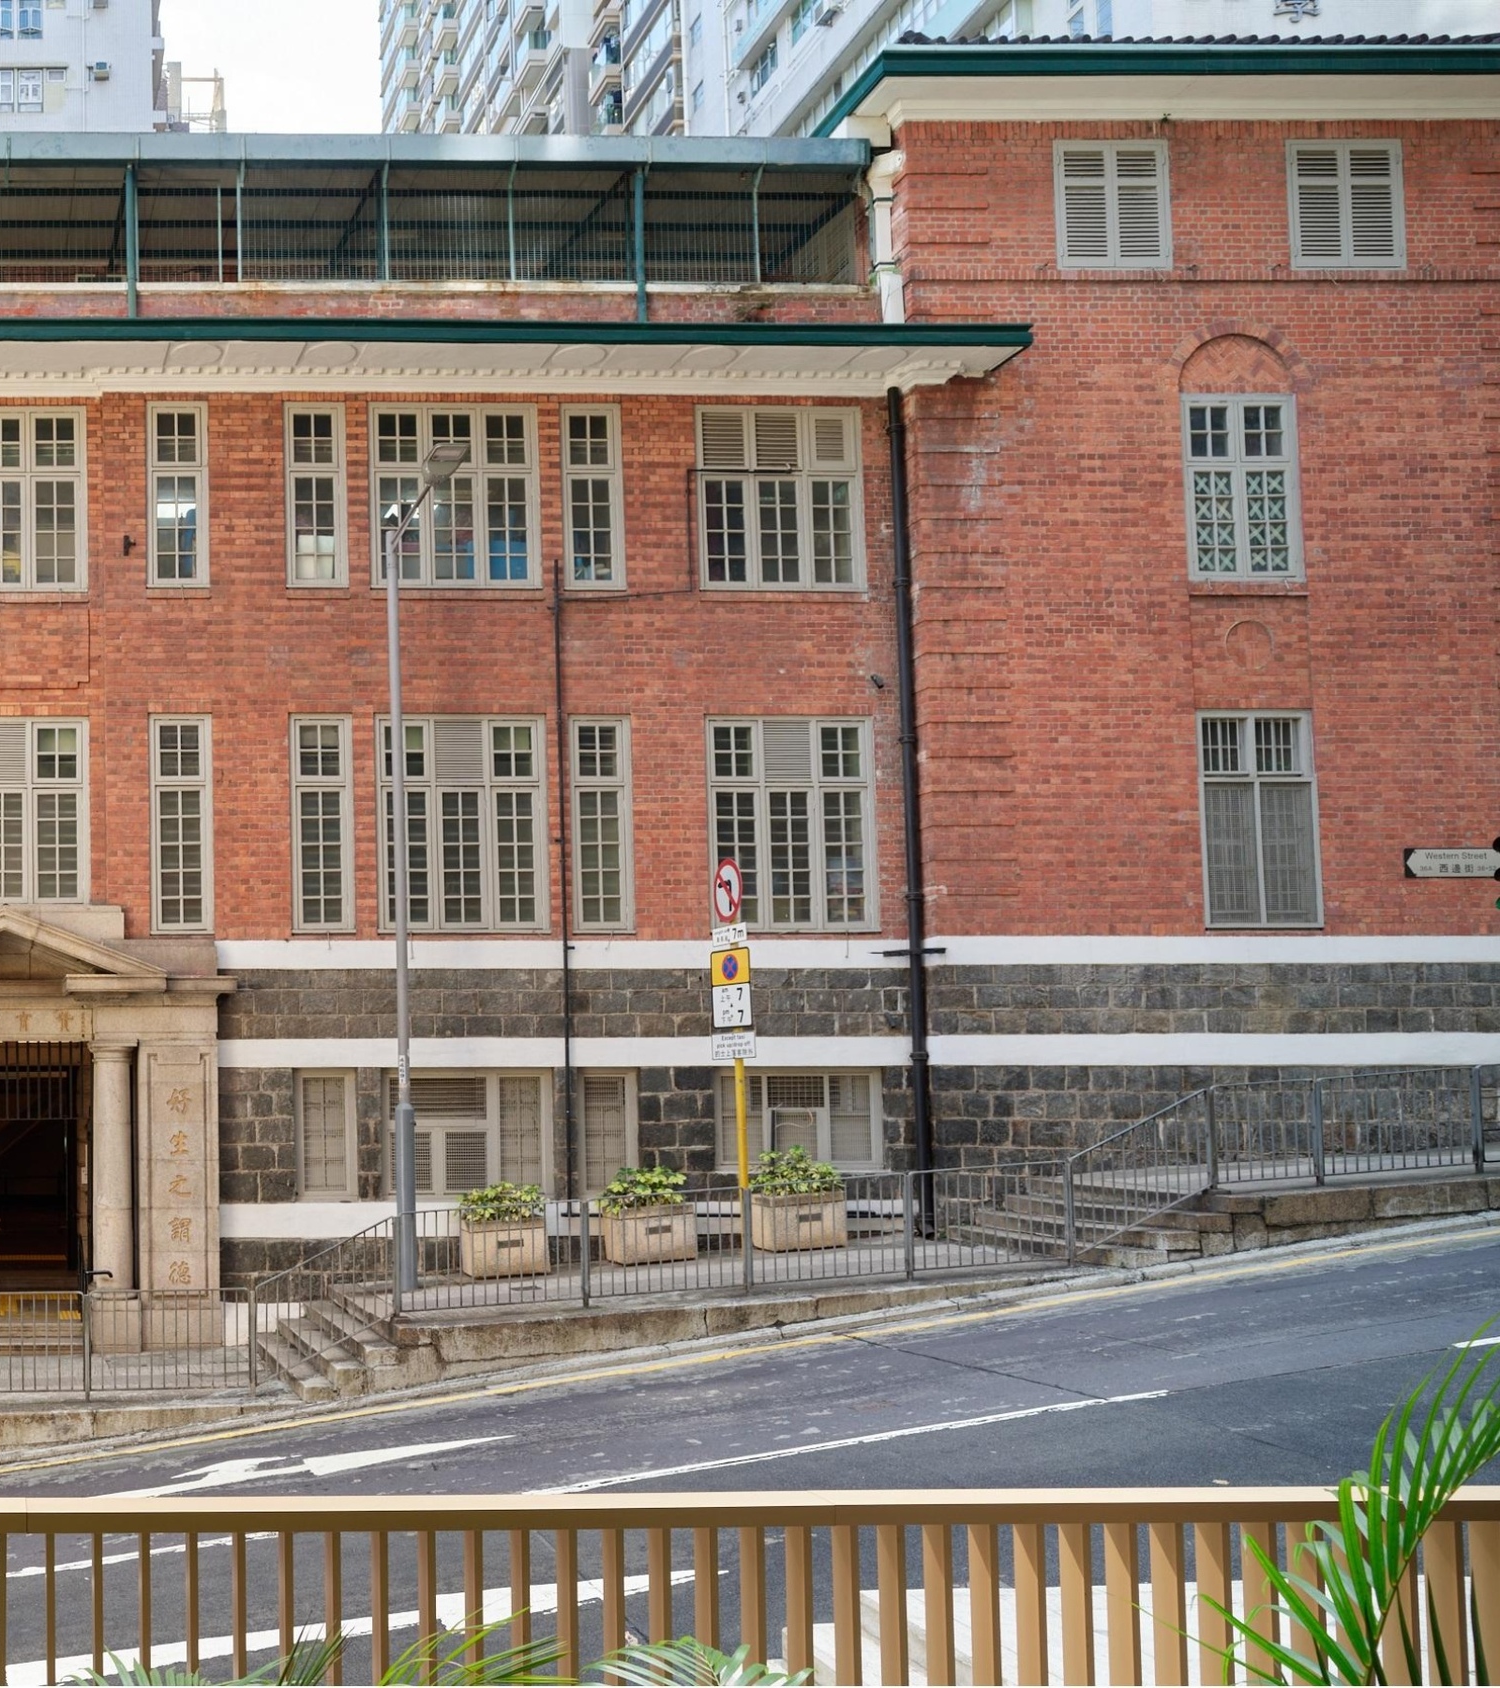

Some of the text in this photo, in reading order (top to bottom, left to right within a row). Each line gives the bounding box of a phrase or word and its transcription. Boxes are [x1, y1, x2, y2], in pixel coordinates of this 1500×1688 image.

[1425, 852, 1487, 860] Western Street
[732, 928, 745, 939] 7m
[736, 987, 743, 1001] 7
[737, 1010, 744, 1023] 7
